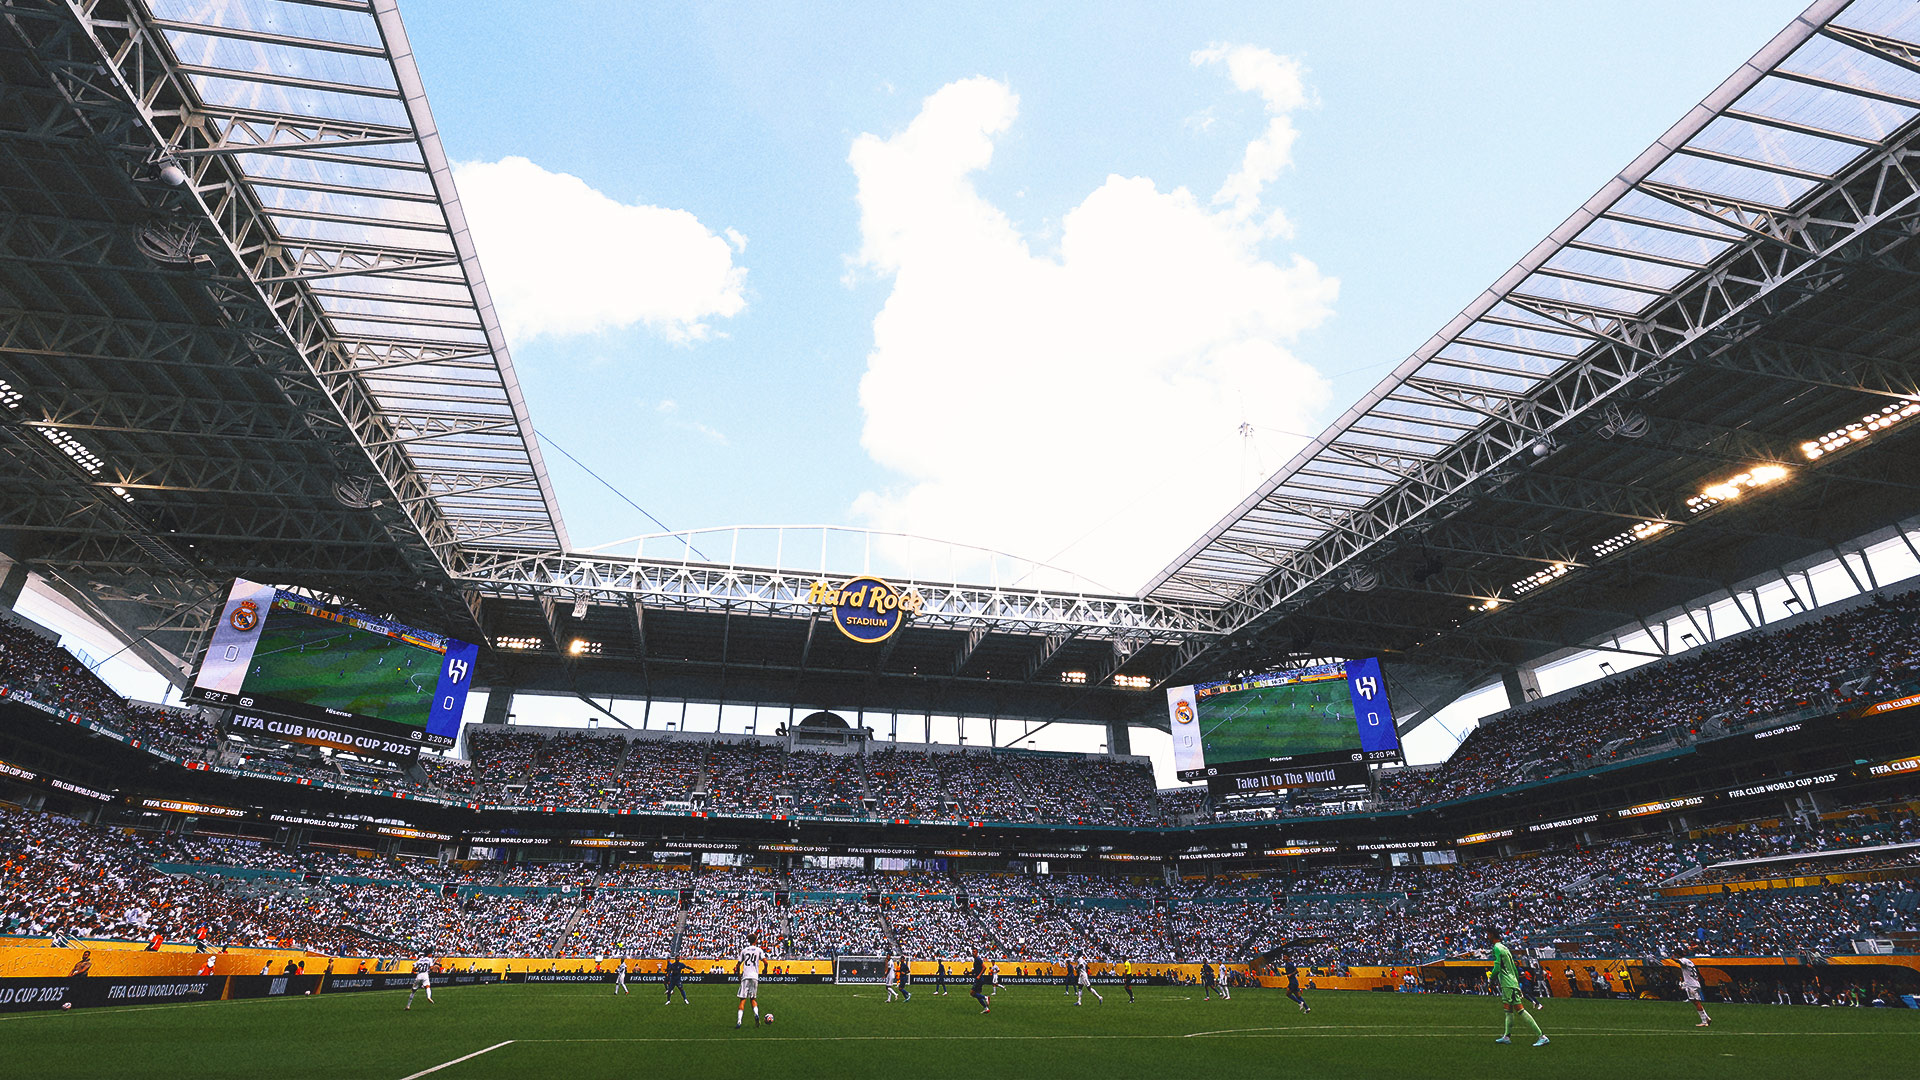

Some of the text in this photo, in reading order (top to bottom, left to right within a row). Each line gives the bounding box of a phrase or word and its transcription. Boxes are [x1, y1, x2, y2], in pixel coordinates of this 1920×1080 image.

[807, 582, 923, 616] Hard Rock
[846, 617, 888, 627] STADIUM
[224, 644, 239, 661] 0
[443, 696, 454, 710] 0
[1876, 700, 1912, 712] FIFA CLUB
[326, 708, 352, 718] Hisense
[1368, 712, 1379, 726] 0
[233, 714, 264, 730] FIFA
[268, 721, 303, 736] CLUB
[306, 728, 352, 745] WORLD
[355, 737, 380, 749] CUP
[1773, 728, 1785, 736] CUP
[428, 734, 453, 746] 3:20 PM
[1184, 734, 1193, 748] 0
[10, 768, 20, 777] CUP
[1870, 761, 1918, 775] FIFA CLUB
[1236, 769, 1336, 790] Take It To The World
[1728, 790, 1744, 798] FIFA
[1746, 786, 1766, 796] CLUB
[1766, 782, 1795, 792] WORLD
[1796, 778, 1812, 786] CUP
[160, 802, 181, 810] CLUB
[182, 804, 209, 812] WORLD
[1632, 806, 1648, 816] CLUB
[1648, 802, 1670, 812] WORLD
[1671, 800, 1684, 808] CUP
[270, 814, 284, 822] FIFA
[285, 816, 302, 824] CLUB
[406, 830, 426, 838] WORLD
[744, 952, 757, 966] 24
[15, 988, 38, 1003] CUP
[108, 984, 188, 998] FIFA CLUB WORLD CUP
